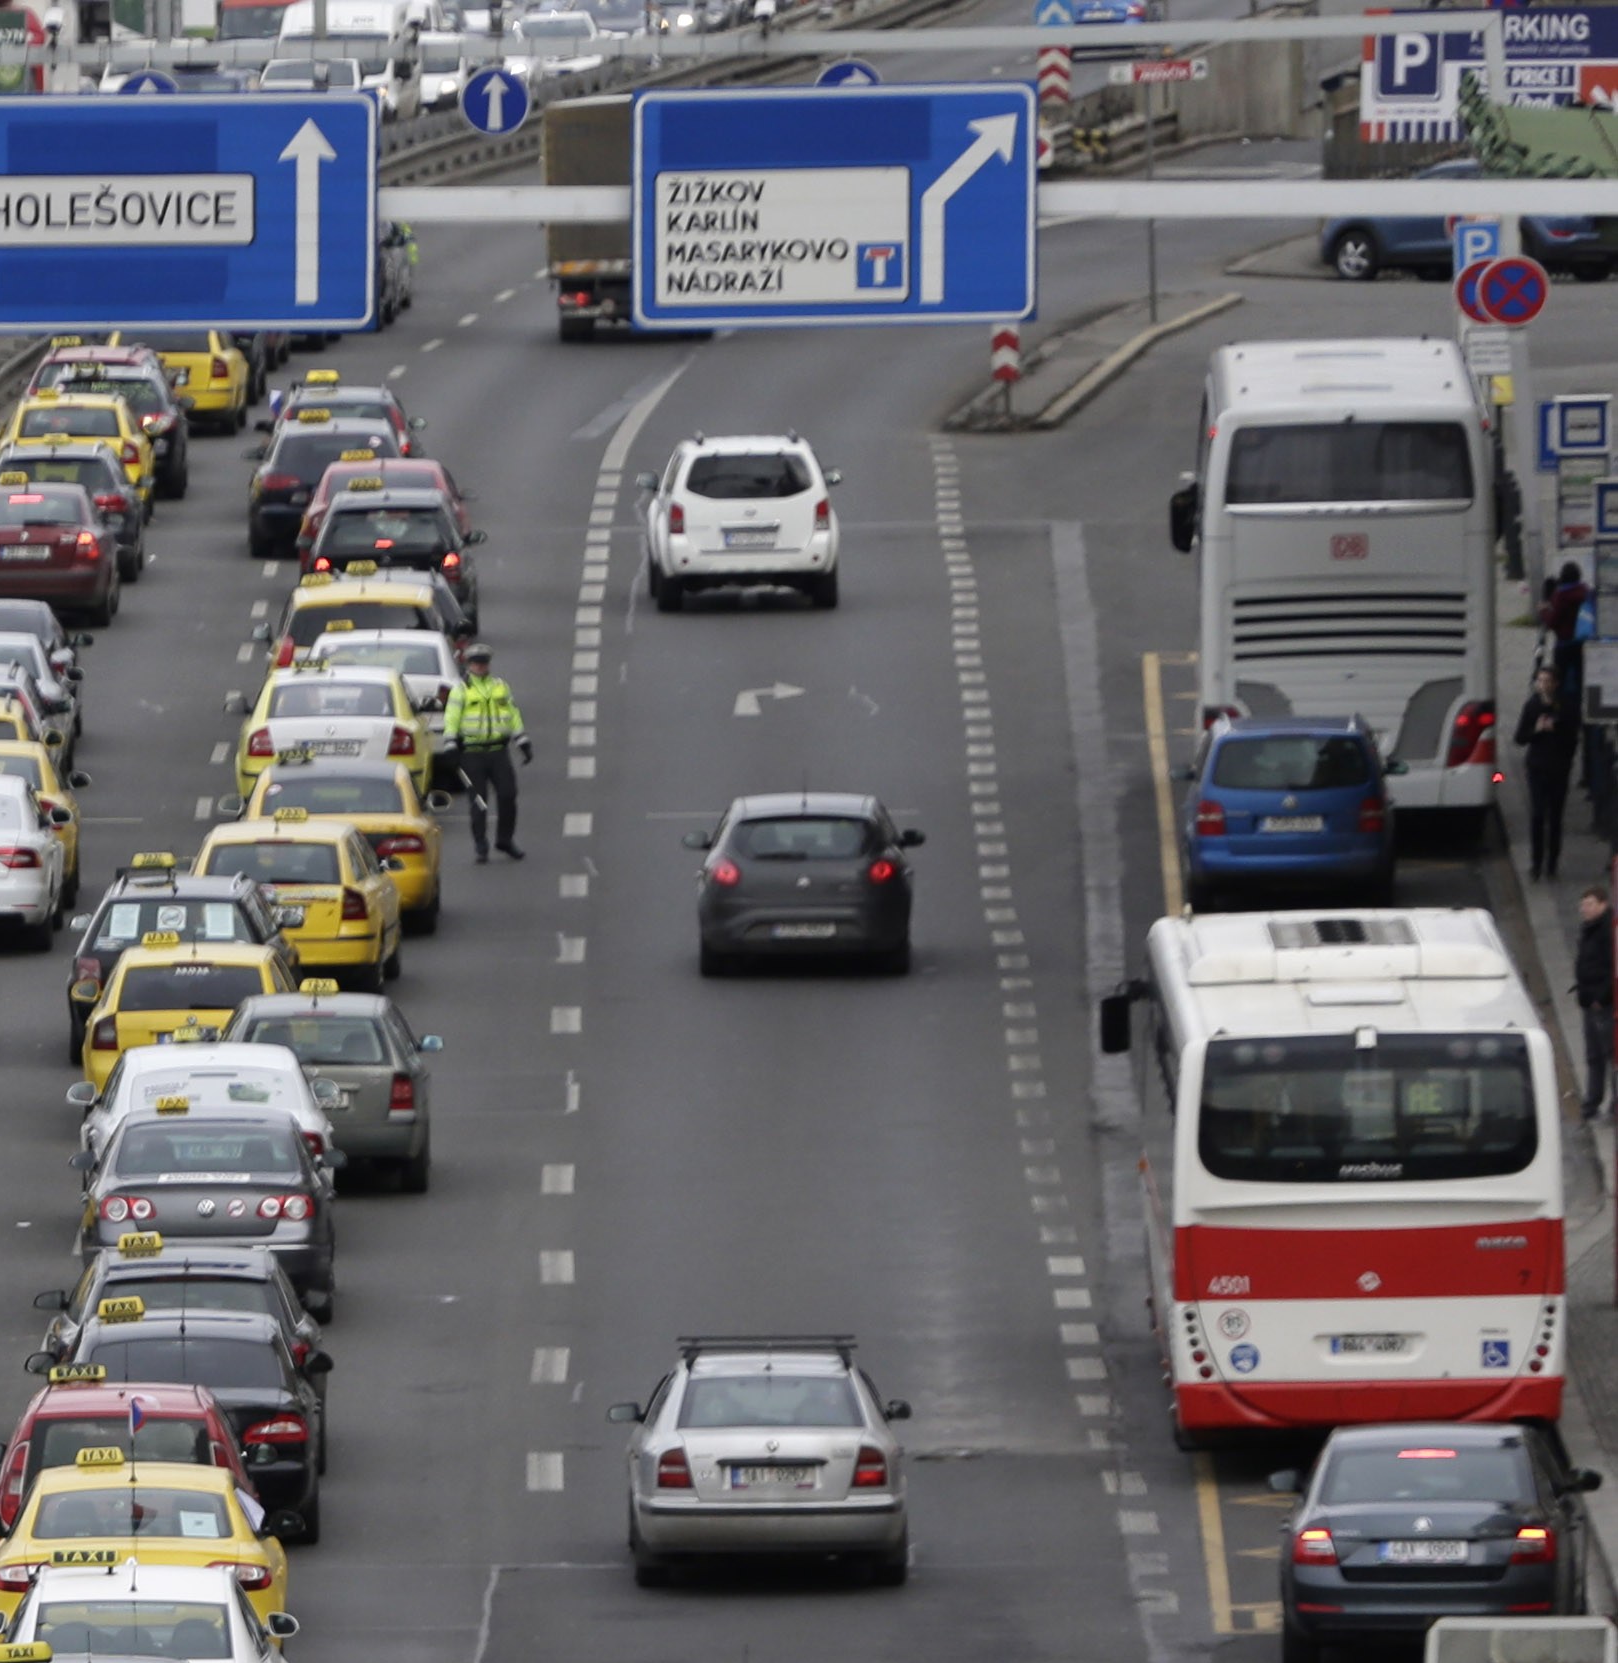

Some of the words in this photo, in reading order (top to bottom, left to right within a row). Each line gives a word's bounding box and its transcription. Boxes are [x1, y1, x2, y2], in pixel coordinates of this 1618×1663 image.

[1470, 14, 1590, 42] RKING
[667, 177, 764, 205] ŽIŽKOV
[667, 206, 759, 233] KARLÍN
[667, 239, 850, 265] MASARYKOVO
[667, 265, 785, 295] NÁDRAŽÍ
[126, 1237, 155, 1247] TAXI
[106, 1303, 137, 1313] TAXI
[60, 1366, 96, 1377] TAXI
[84, 1450, 117, 1461] TAXI
[61, 1550, 109, 1562] TAXI
[6, 1647, 35, 1658] TAXI
